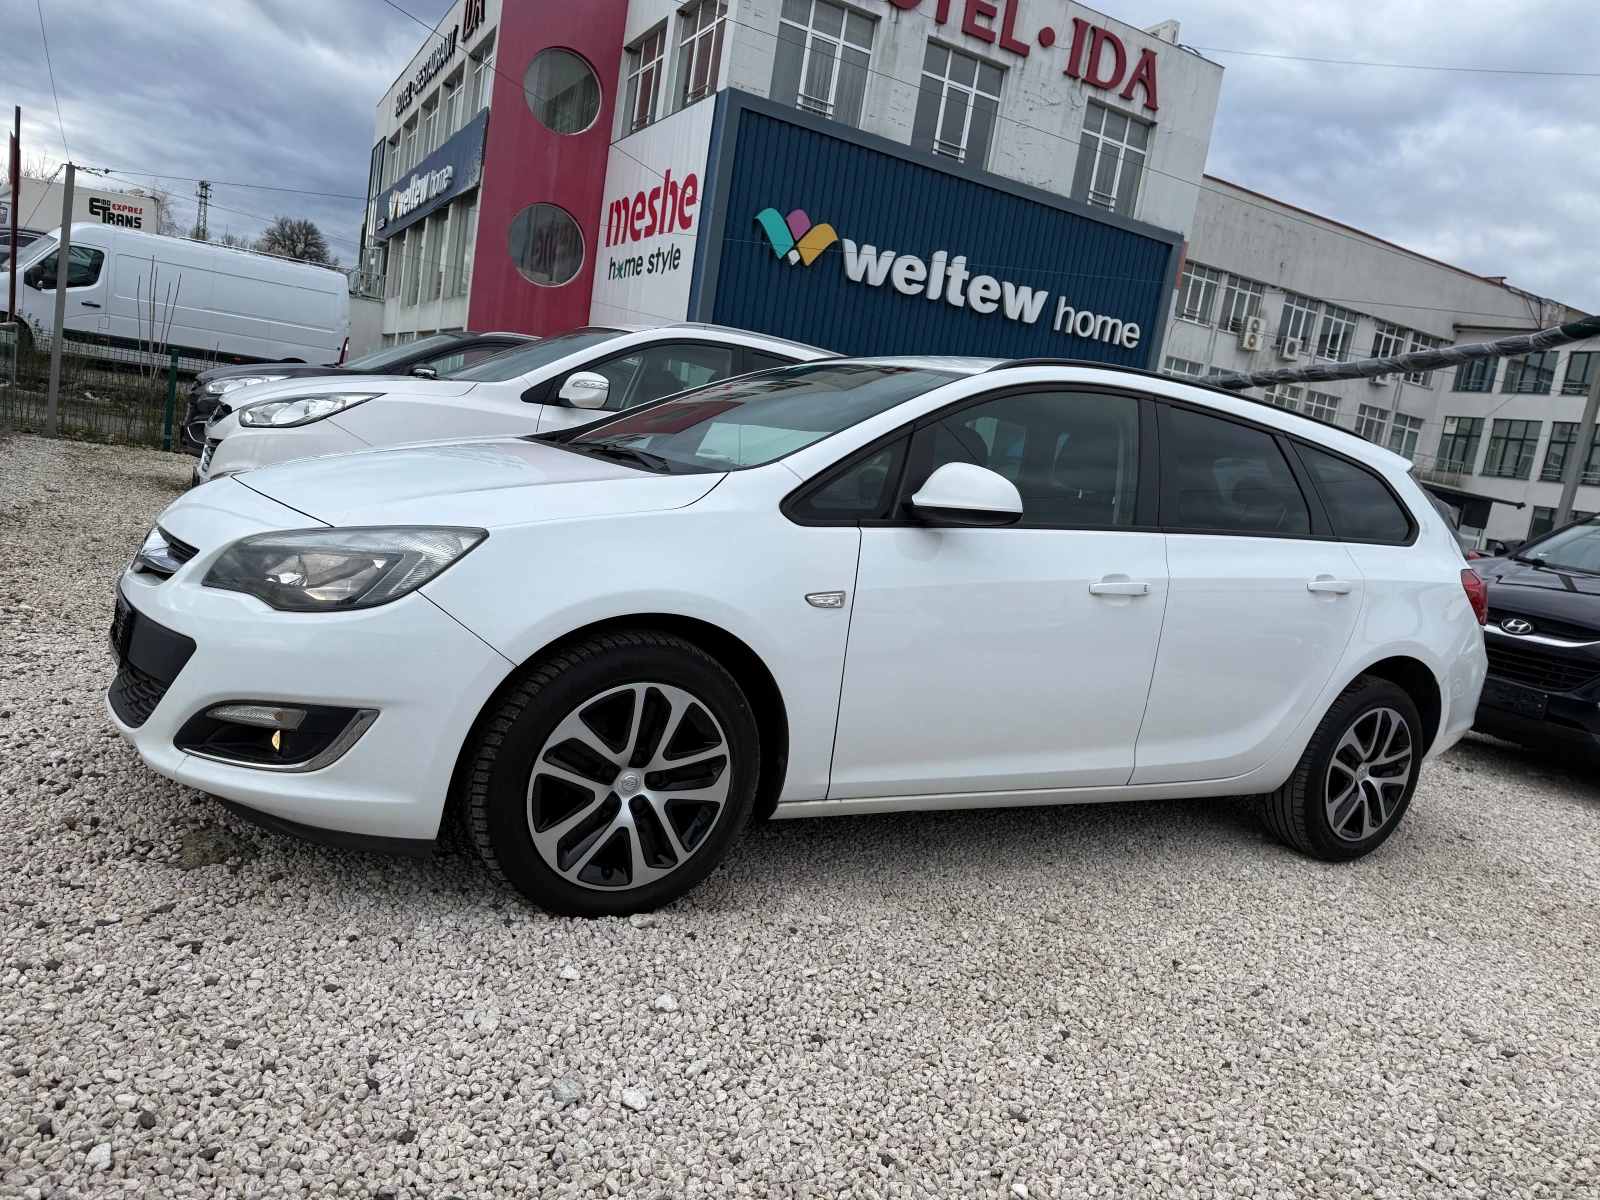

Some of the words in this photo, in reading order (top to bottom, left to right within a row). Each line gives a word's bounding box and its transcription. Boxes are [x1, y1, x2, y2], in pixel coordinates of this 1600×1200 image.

[889, 0, 1031, 58] EL
[1064, 17, 1159, 111] IDA
[112, 203, 143, 215] EXPRES
[605, 168, 698, 248] meshe
[646, 242, 681, 275] style
[842, 238, 1049, 324] weltew
[1053, 295, 1141, 349] home
